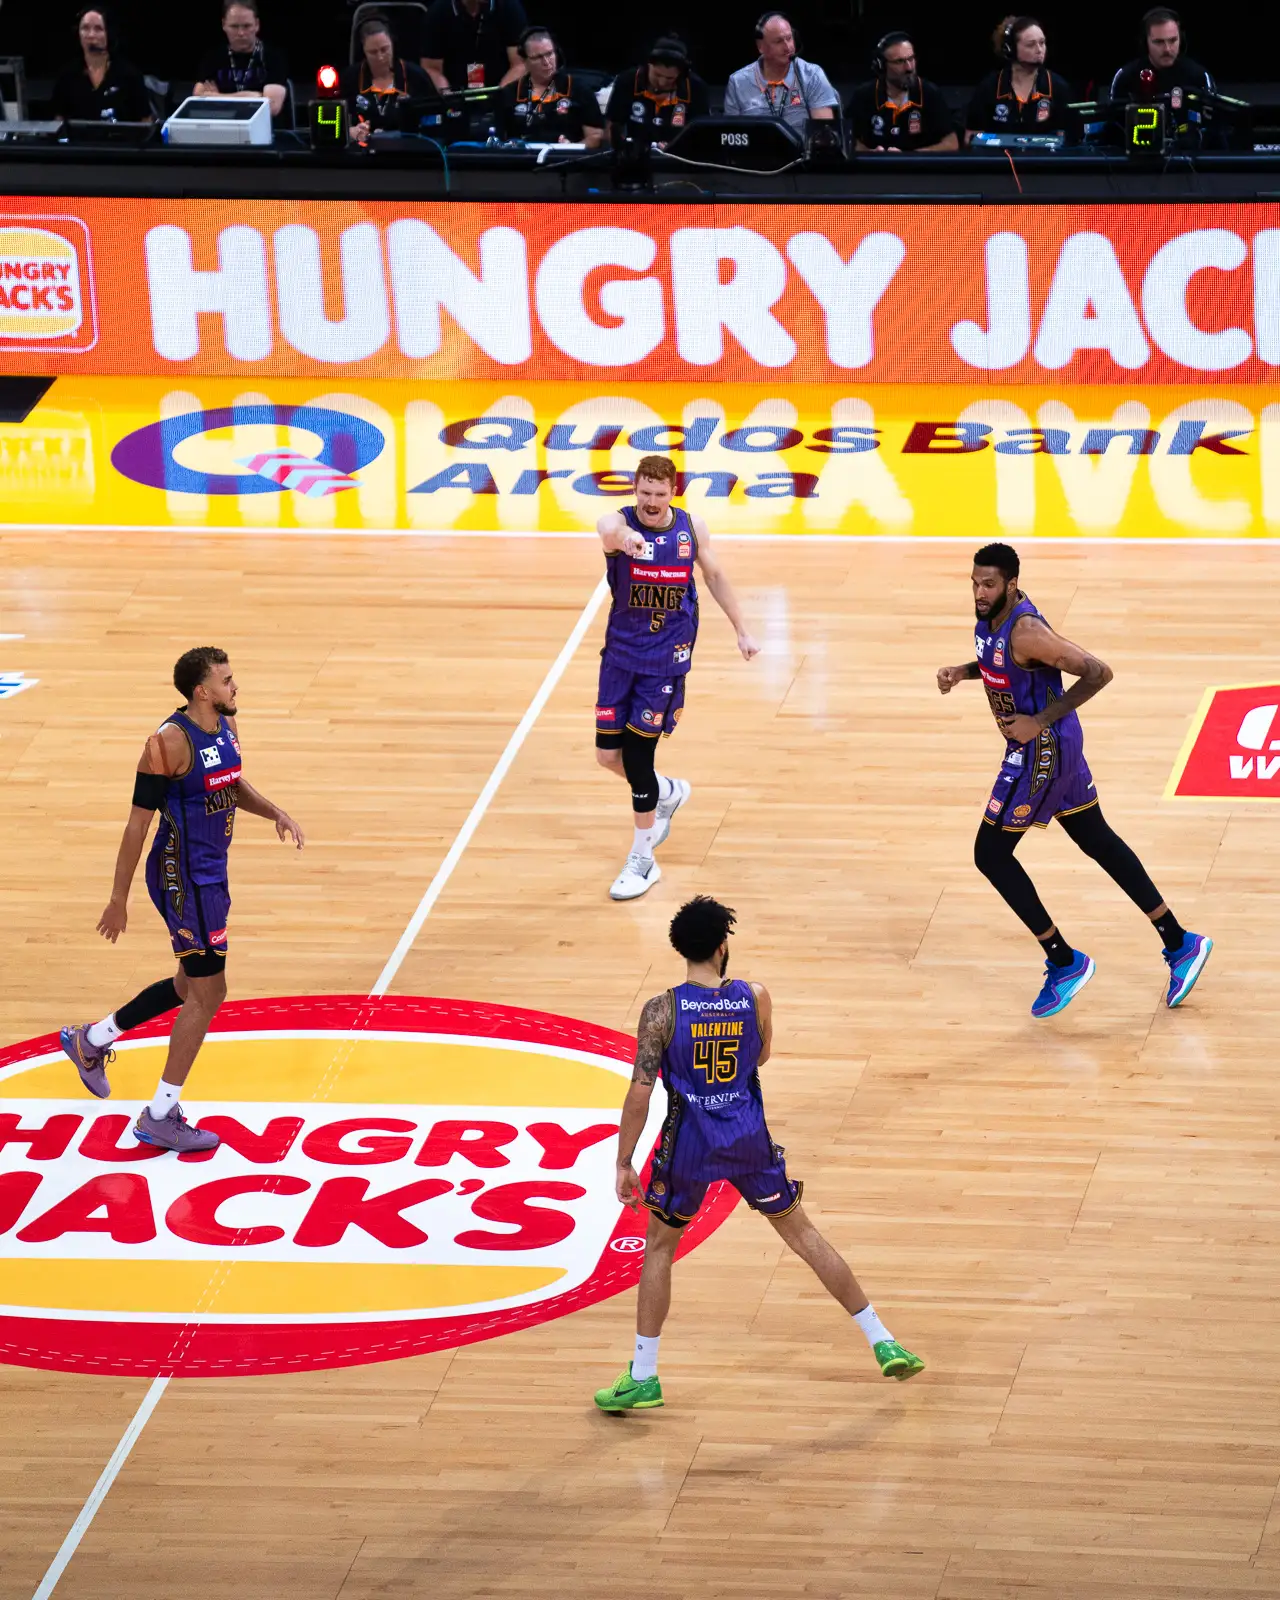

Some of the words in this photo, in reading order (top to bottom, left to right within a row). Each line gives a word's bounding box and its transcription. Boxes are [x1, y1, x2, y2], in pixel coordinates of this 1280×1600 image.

[317, 106, 341, 139] 4
[720, 132, 749, 147] POSS
[1132, 108, 1158, 146] 2
[0, 261, 71, 282] NGRY
[144, 217, 906, 370] HUNGRY
[950, 227, 1280, 372] JAC
[439, 416, 883, 455] Qudos
[900, 420, 1257, 456] Bank
[407, 463, 821, 499] Arena
[632, 567, 660, 579] Harvey
[649, 610, 666, 633] 5
[691, 1022, 744, 1038] VALENTINE
[693, 1039, 739, 1084] 45
[0, 1112, 620, 1171] HUNGRY
